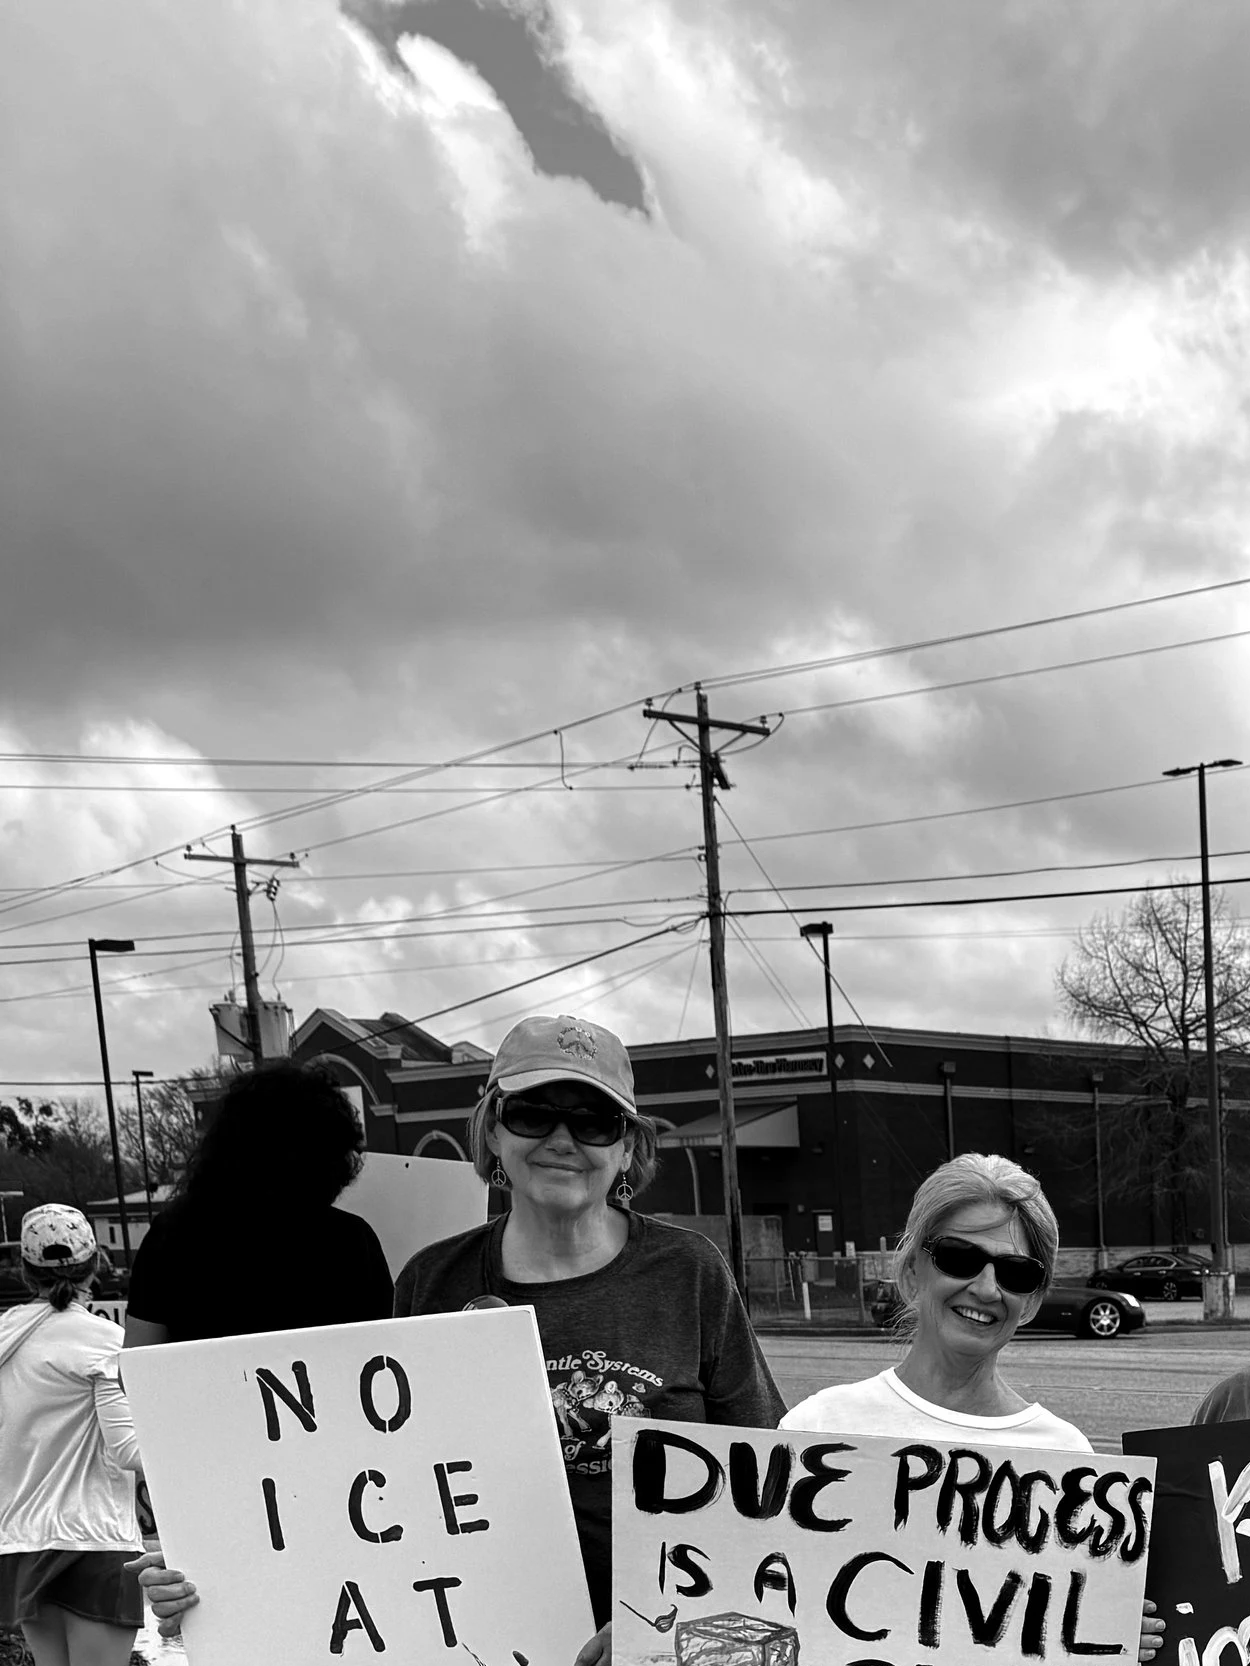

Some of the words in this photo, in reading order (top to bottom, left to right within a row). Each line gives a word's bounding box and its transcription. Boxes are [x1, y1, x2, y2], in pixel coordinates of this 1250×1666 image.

[256, 1355, 412, 1441] NO
[546, 1354, 582, 1371] ntle
[581, 1350, 664, 1387] Systems
[564, 1441, 586, 1461] of
[262, 1460, 490, 1551] ICE
[631, 1428, 858, 1533] DUE
[890, 1444, 1153, 1565] PROCESS
[329, 1577, 463, 1656] AT
[659, 1541, 713, 1599] IS
[754, 1551, 798, 1617] A
[825, 1551, 1125, 1658] CIVIL
